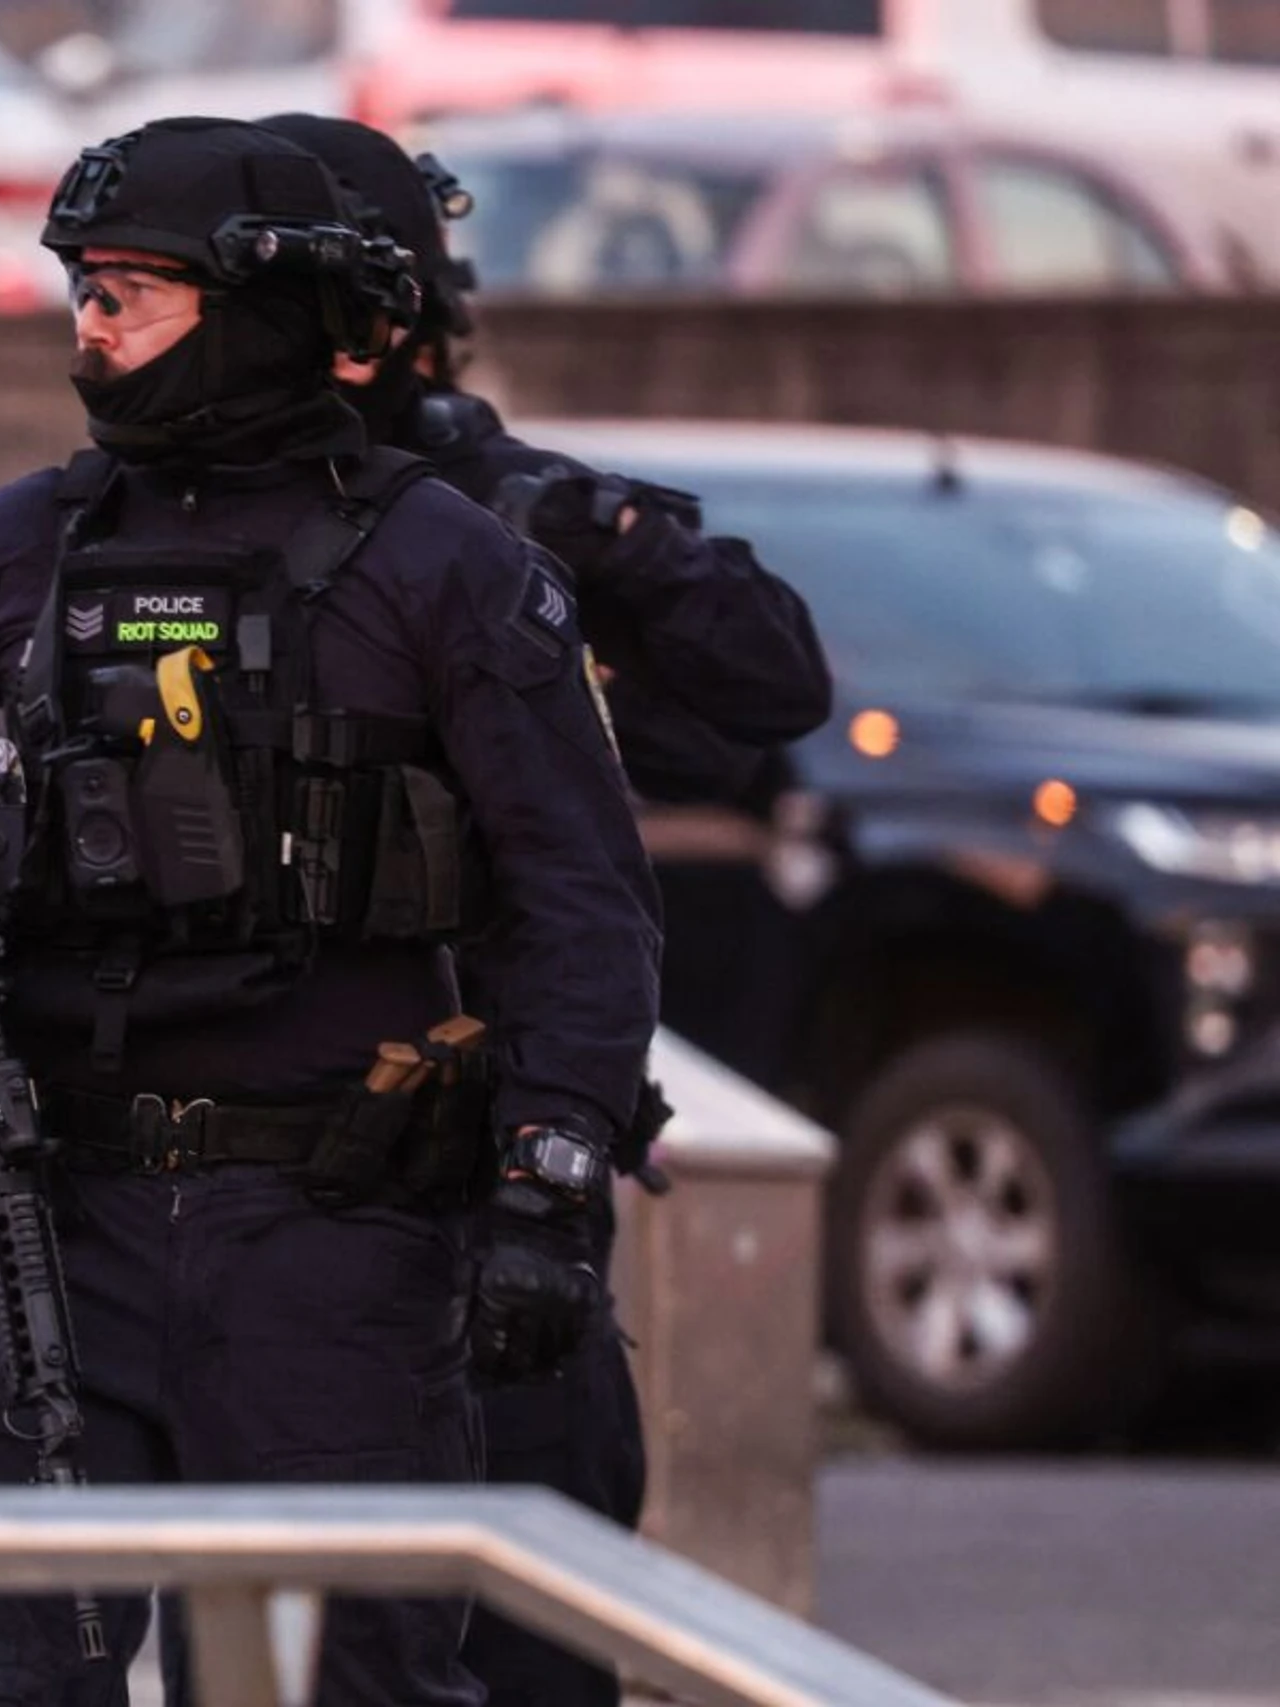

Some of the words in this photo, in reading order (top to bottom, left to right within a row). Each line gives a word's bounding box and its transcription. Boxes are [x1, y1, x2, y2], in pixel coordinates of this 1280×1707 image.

[134, 597, 204, 614] POLICE
[118, 622, 156, 641] RIOT
[158, 622, 219, 641] SQUAD
